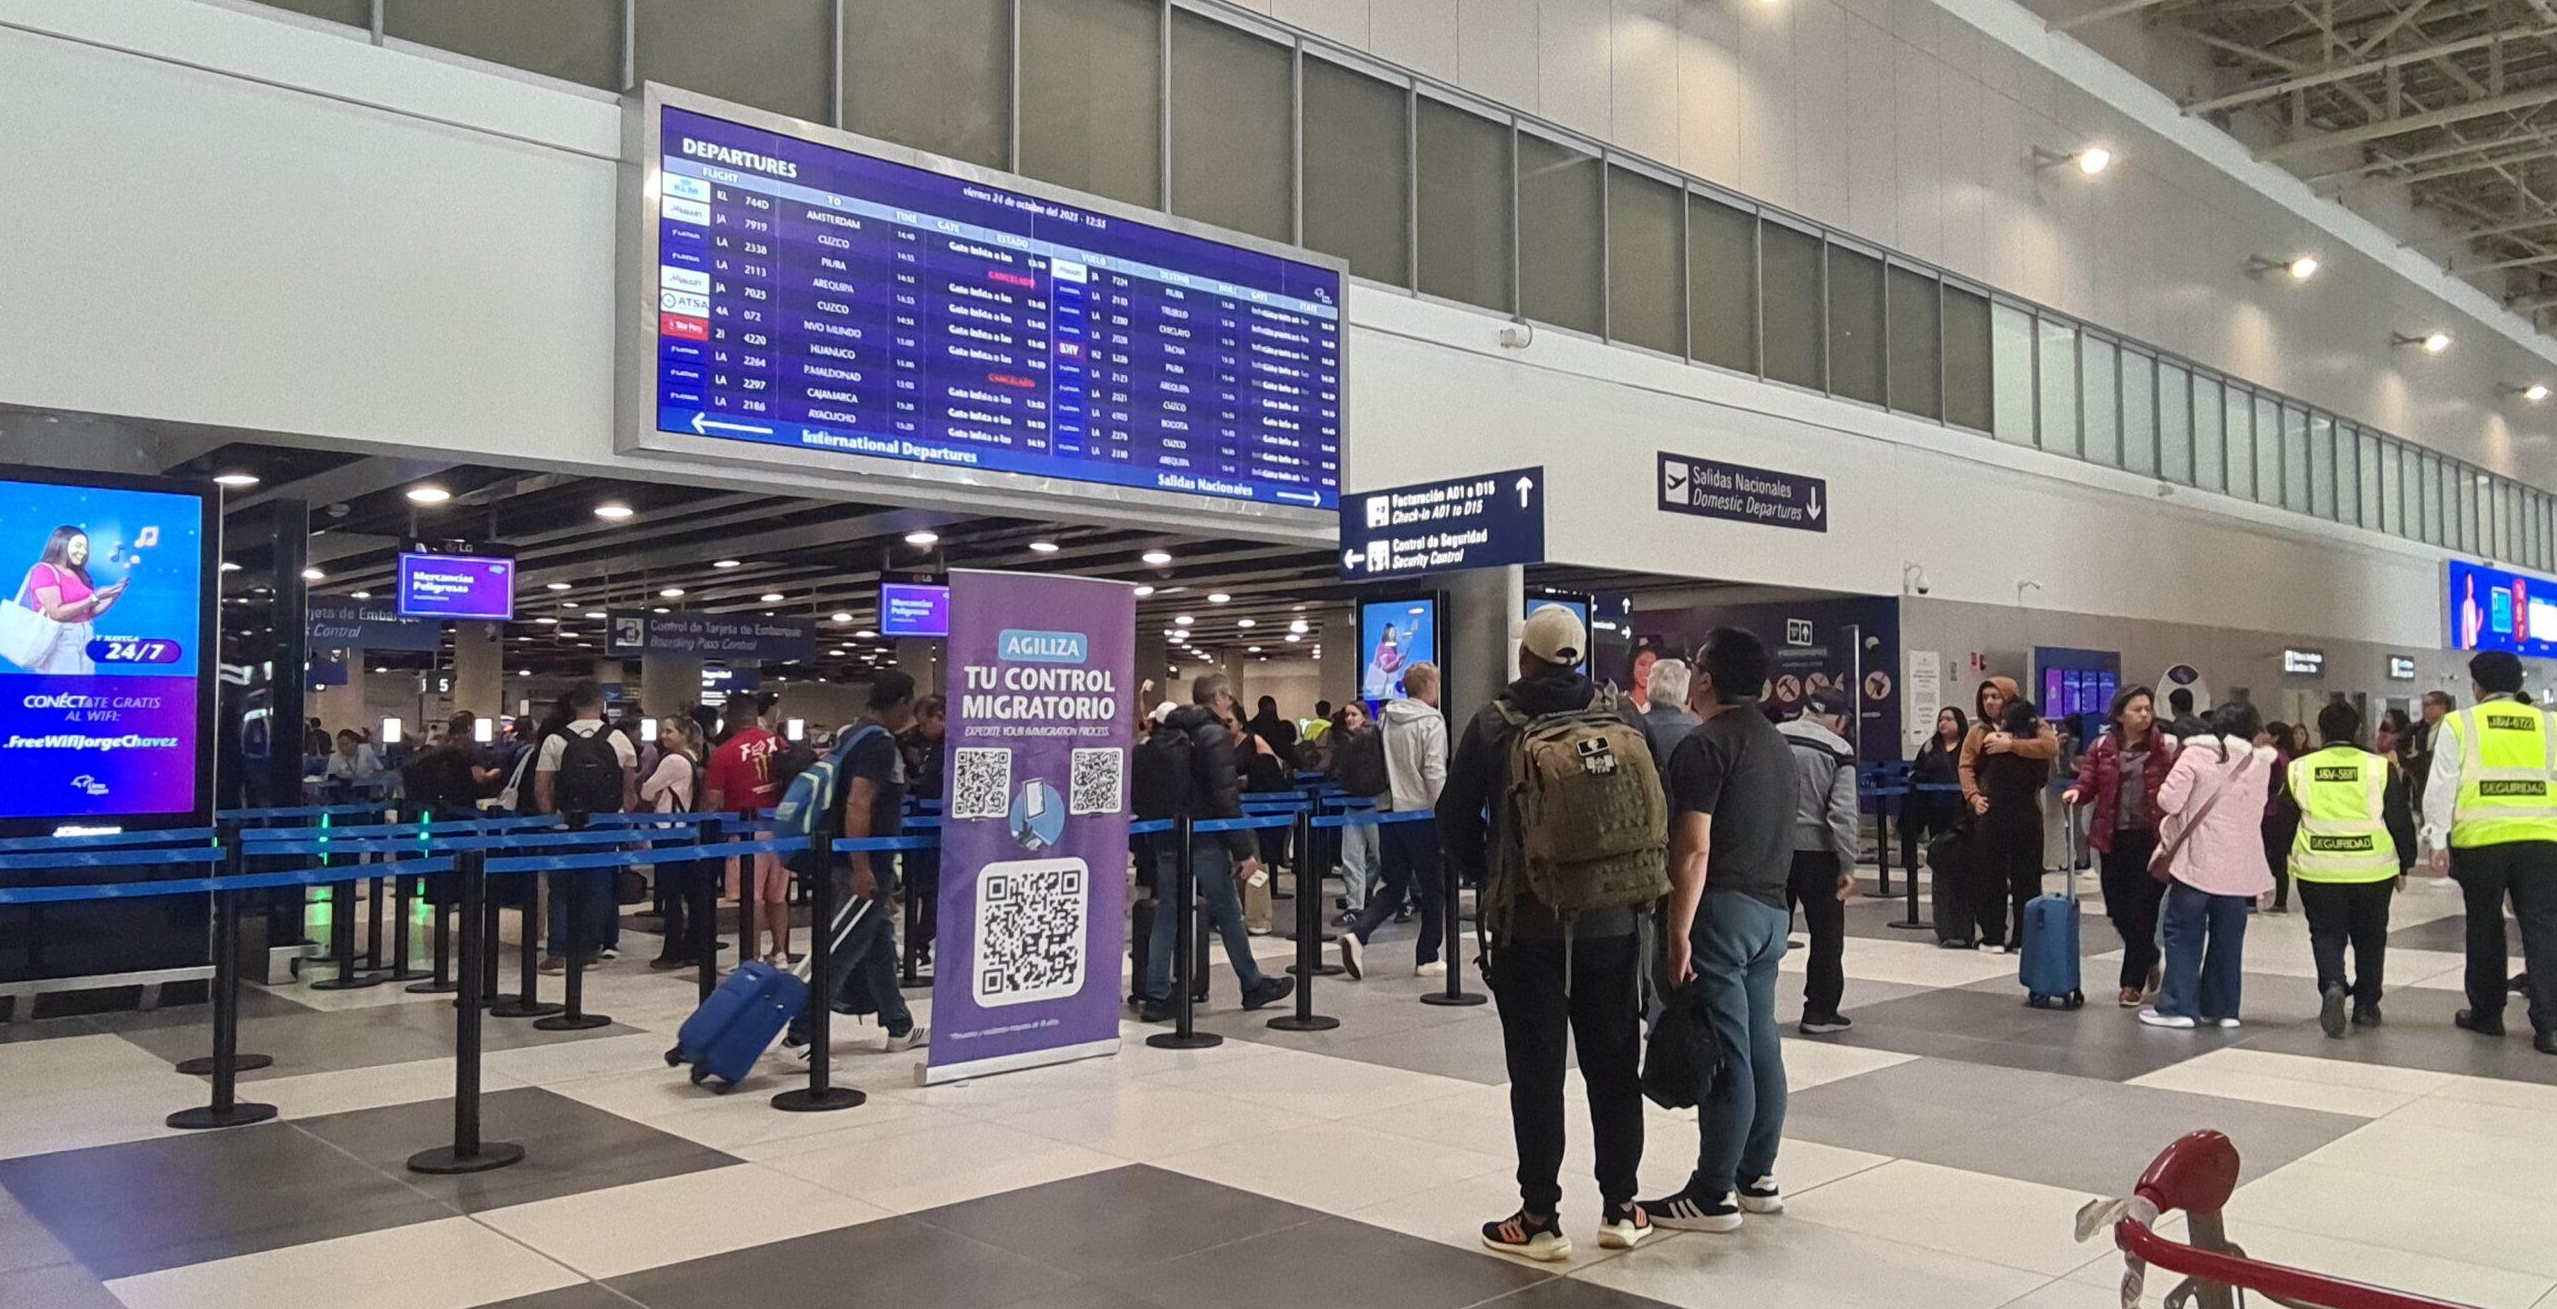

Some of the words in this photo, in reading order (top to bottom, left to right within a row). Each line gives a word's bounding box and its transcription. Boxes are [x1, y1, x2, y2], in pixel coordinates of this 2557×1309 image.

[682, 138, 798, 178] DEPARTURES
[702, 167, 739, 183] FLIGHT
[828, 195, 842, 207] TO
[896, 211, 918, 225] TIME
[996, 233, 1029, 249] ESTADO
[717, 190, 728, 201] KL
[806, 210, 861, 229] AMSTERDAM
[962, 186, 991, 202] viernes
[992, 193, 1003, 205] 24
[1004, 195, 1015, 207] de
[1046, 206, 1058, 217] del
[717, 213, 727, 224] JA
[745, 219, 768, 232] 7919
[817, 234, 850, 249] CUZCO
[716, 236, 728, 248] LA
[744, 242, 768, 255] 2338
[821, 256, 847, 271] PIURA
[716, 259, 728, 270] LA
[744, 265, 767, 278] 2113
[812, 278, 855, 295] AREQUIPA
[678, 297, 710, 310] ATSA
[716, 282, 726, 294] JA
[817, 300, 849, 315] CUZCO
[716, 306, 728, 316] 4A
[803, 319, 824, 334] NVO
[826, 323, 862, 340] MUNDO
[715, 352, 728, 362] LA
[810, 343, 856, 360] HUANUCO
[715, 375, 728, 386] LA
[807, 388, 858, 404] CAJAMARCA
[714, 396, 727, 406] LA
[807, 408, 857, 424] AYACUCHO
[802, 429, 899, 454] International
[902, 441, 978, 465] Departures
[1157, 473, 1196, 490] Salidas
[1197, 479, 1253, 497] Nacionales
[1392, 488, 1444, 508] Facturación
[1446, 484, 1464, 501] A01
[1476, 480, 1495, 497] D15
[1693, 466, 1732, 490] Salidas
[1735, 473, 1792, 499] Nacionales
[1392, 506, 1430, 526] Check-in
[1432, 504, 1450, 521] A01
[1452, 504, 1462, 517] to
[1464, 499, 1483, 516] D15
[1692, 487, 1744, 513] Domestic
[1745, 497, 1803, 522] Departures
[1393, 535, 1425, 553] Control
[1427, 536, 1439, 548] de
[1441, 528, 1488, 551] Seguridad
[1392, 552, 1429, 570] Security
[1430, 548, 1464, 566] Control
[413, 571, 474, 584] Mercancías
[413, 581, 469, 595] Peligrosas
[339, 608, 356, 620] de
[313, 624, 361, 639] Control
[650, 619, 688, 633] Control
[690, 622, 702, 633] de
[705, 621, 738, 636] Tarjeta
[740, 624, 752, 635] de
[754, 624, 802, 639] Embarque
[105, 643, 165, 662] 24/7
[650, 635, 695, 652] Boarding
[699, 637, 720, 650] Pass
[721, 638, 758, 651] Control
[1006, 636, 1080, 657] AGILIZA
[439, 678, 449, 692] 5
[963, 665, 997, 690] TU
[1004, 667, 1115, 692] CONTROL
[23, 691, 109, 709] CONÉCTATE
[112, 696, 161, 709] GRATIS
[962, 695, 1116, 720] MIGRATORIO
[64, 710, 82, 722] AL
[86, 710, 121, 722] WIFI:
[1003, 726, 1025, 737] YOUR
[2481, 782, 2546, 795] SEGURIDAD
[2311, 837, 2371, 850] SEGURIDAD
